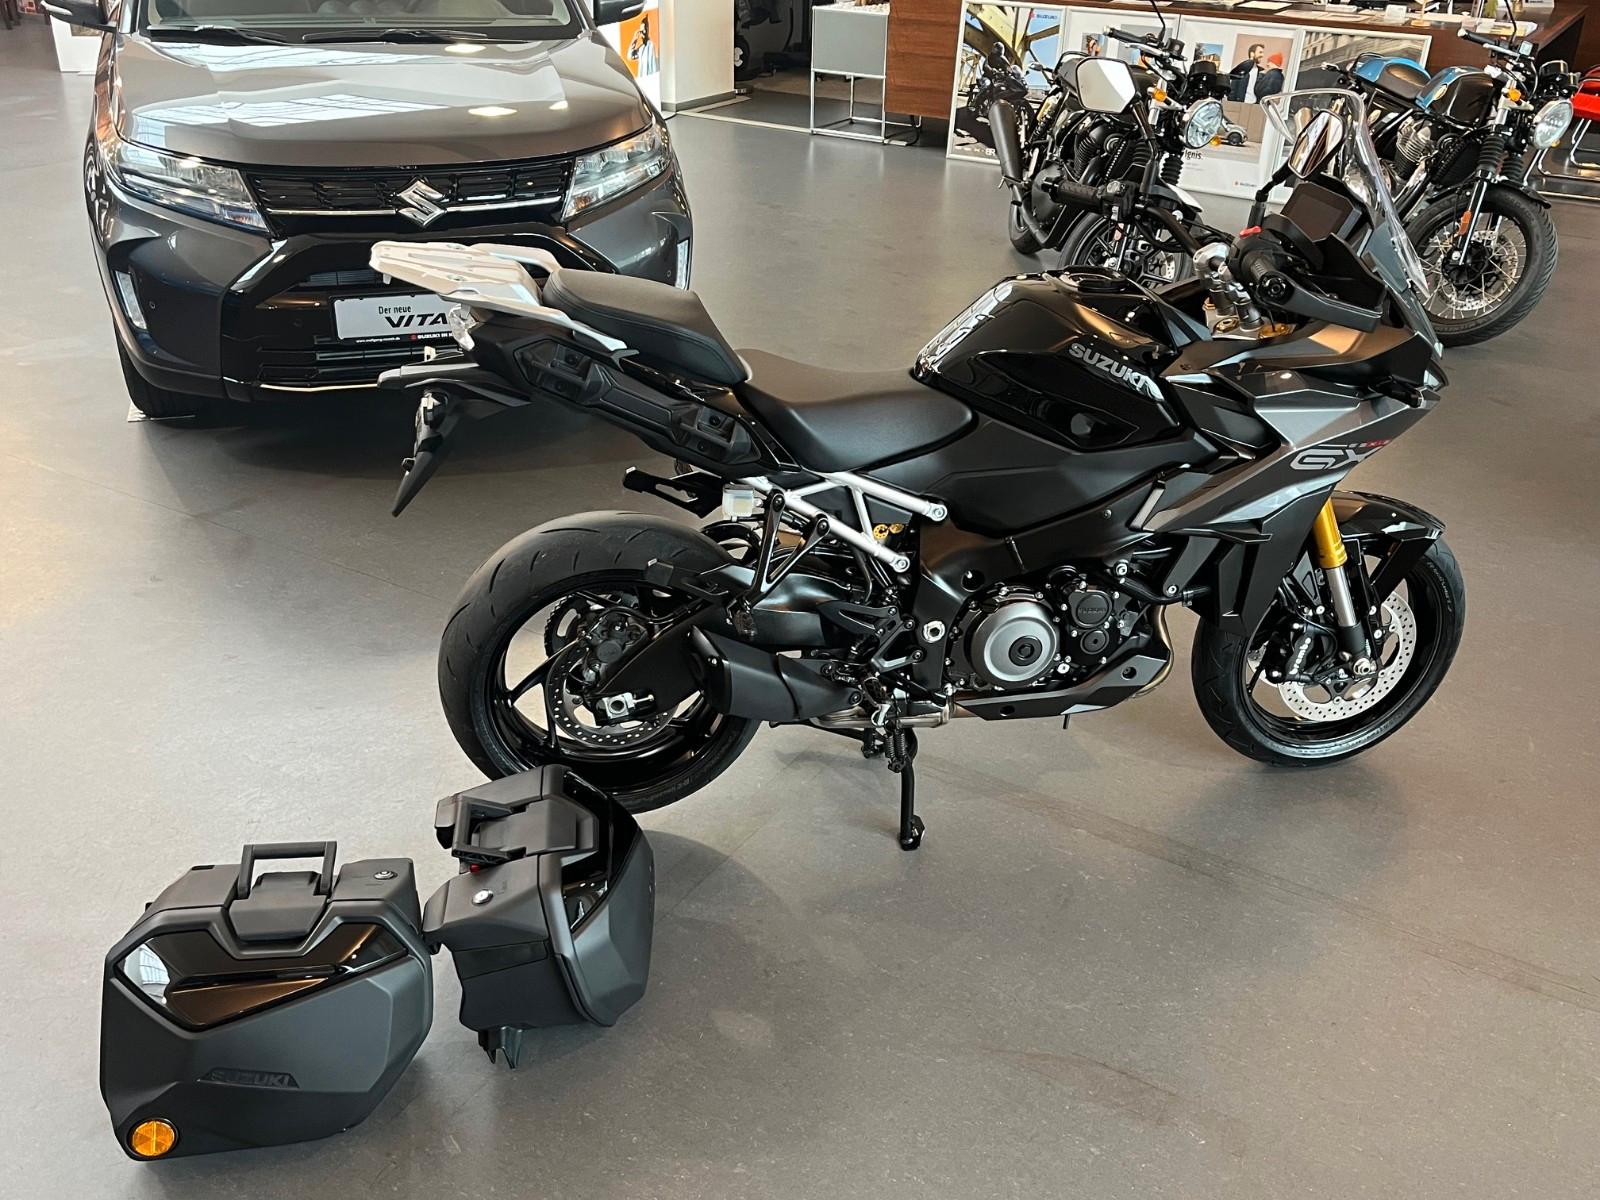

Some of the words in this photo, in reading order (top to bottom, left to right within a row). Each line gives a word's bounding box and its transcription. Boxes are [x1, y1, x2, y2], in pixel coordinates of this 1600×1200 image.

[378, 305, 392, 315] Der
[393, 305, 412, 314] neue
[384, 312, 449, 329] VITA
[1068, 342, 1148, 392] SUZUKI
[1288, 637, 1312, 675] brembo
